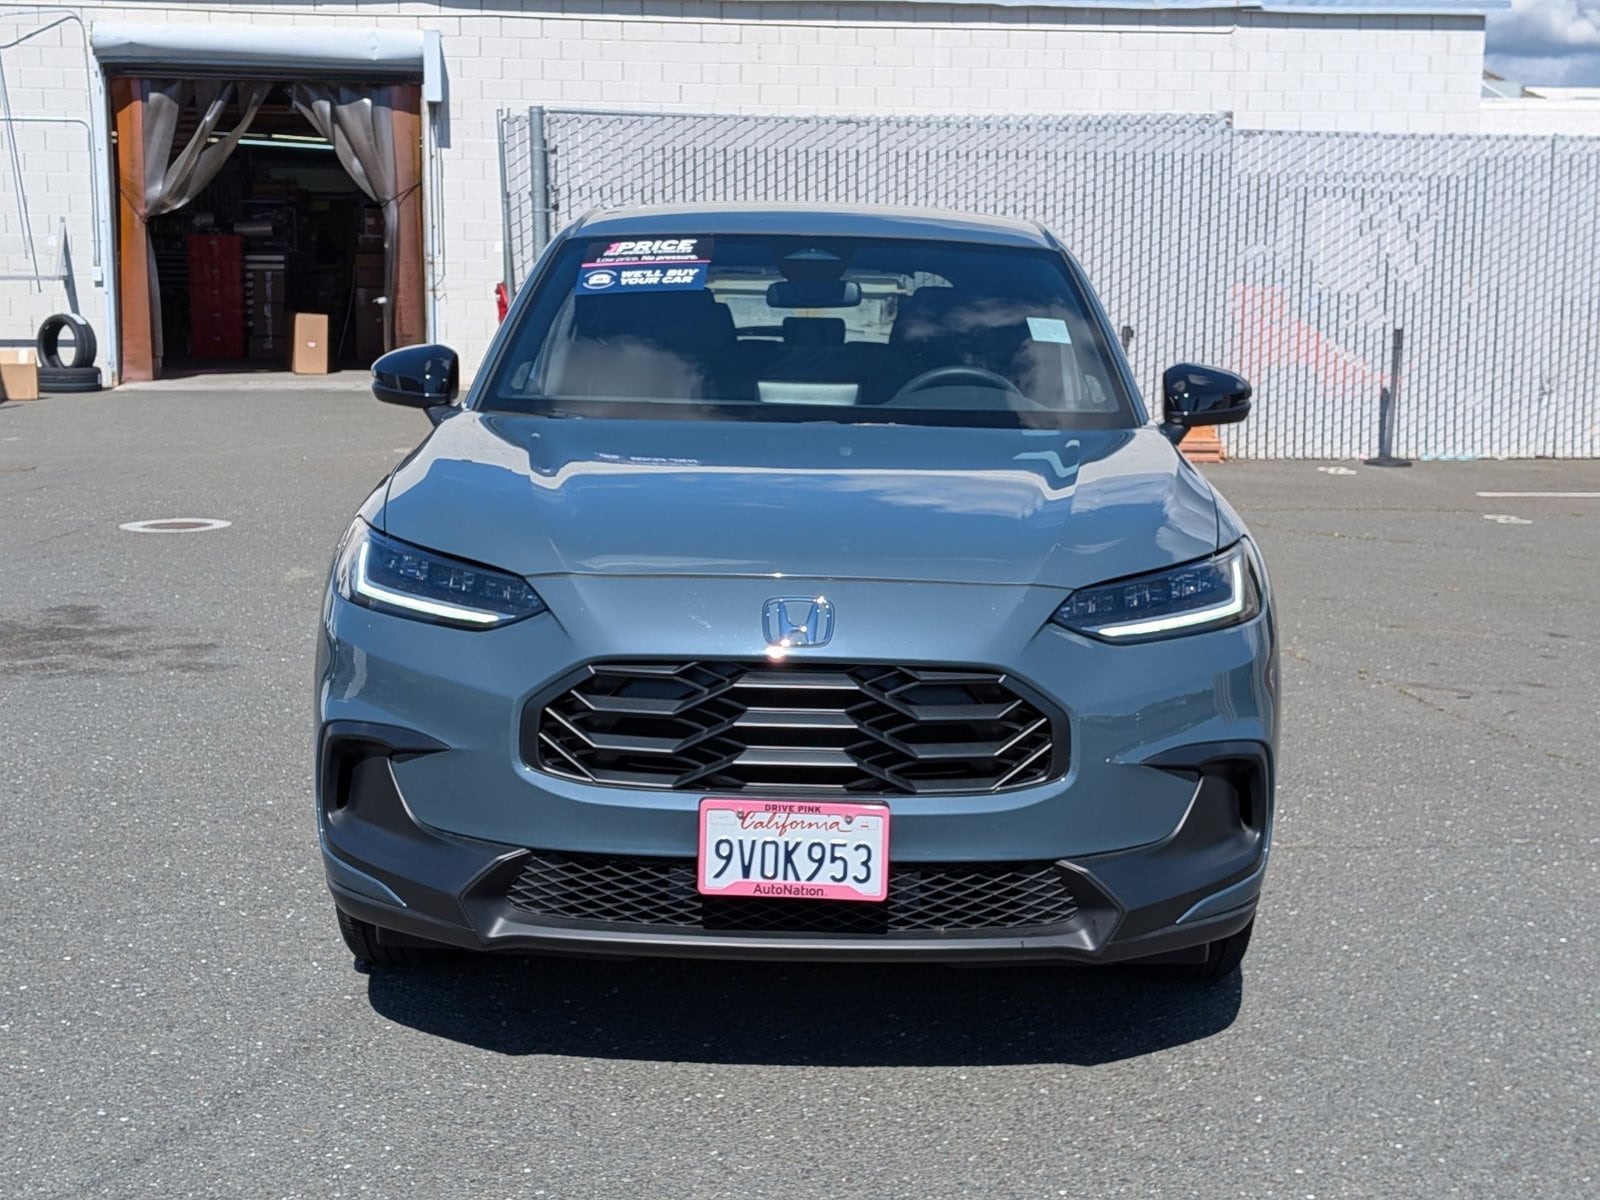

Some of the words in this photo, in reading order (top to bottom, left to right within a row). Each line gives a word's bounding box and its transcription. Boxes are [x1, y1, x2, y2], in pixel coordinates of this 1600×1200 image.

[665, 268, 700, 277] BUY
[620, 277, 660, 286] YOUR
[662, 276, 695, 284] CAR
[764, 803, 795, 813] DRIVE
[797, 804, 822, 814] PINK
[740, 811, 853, 838] California
[752, 883, 825, 897] AutoNation
